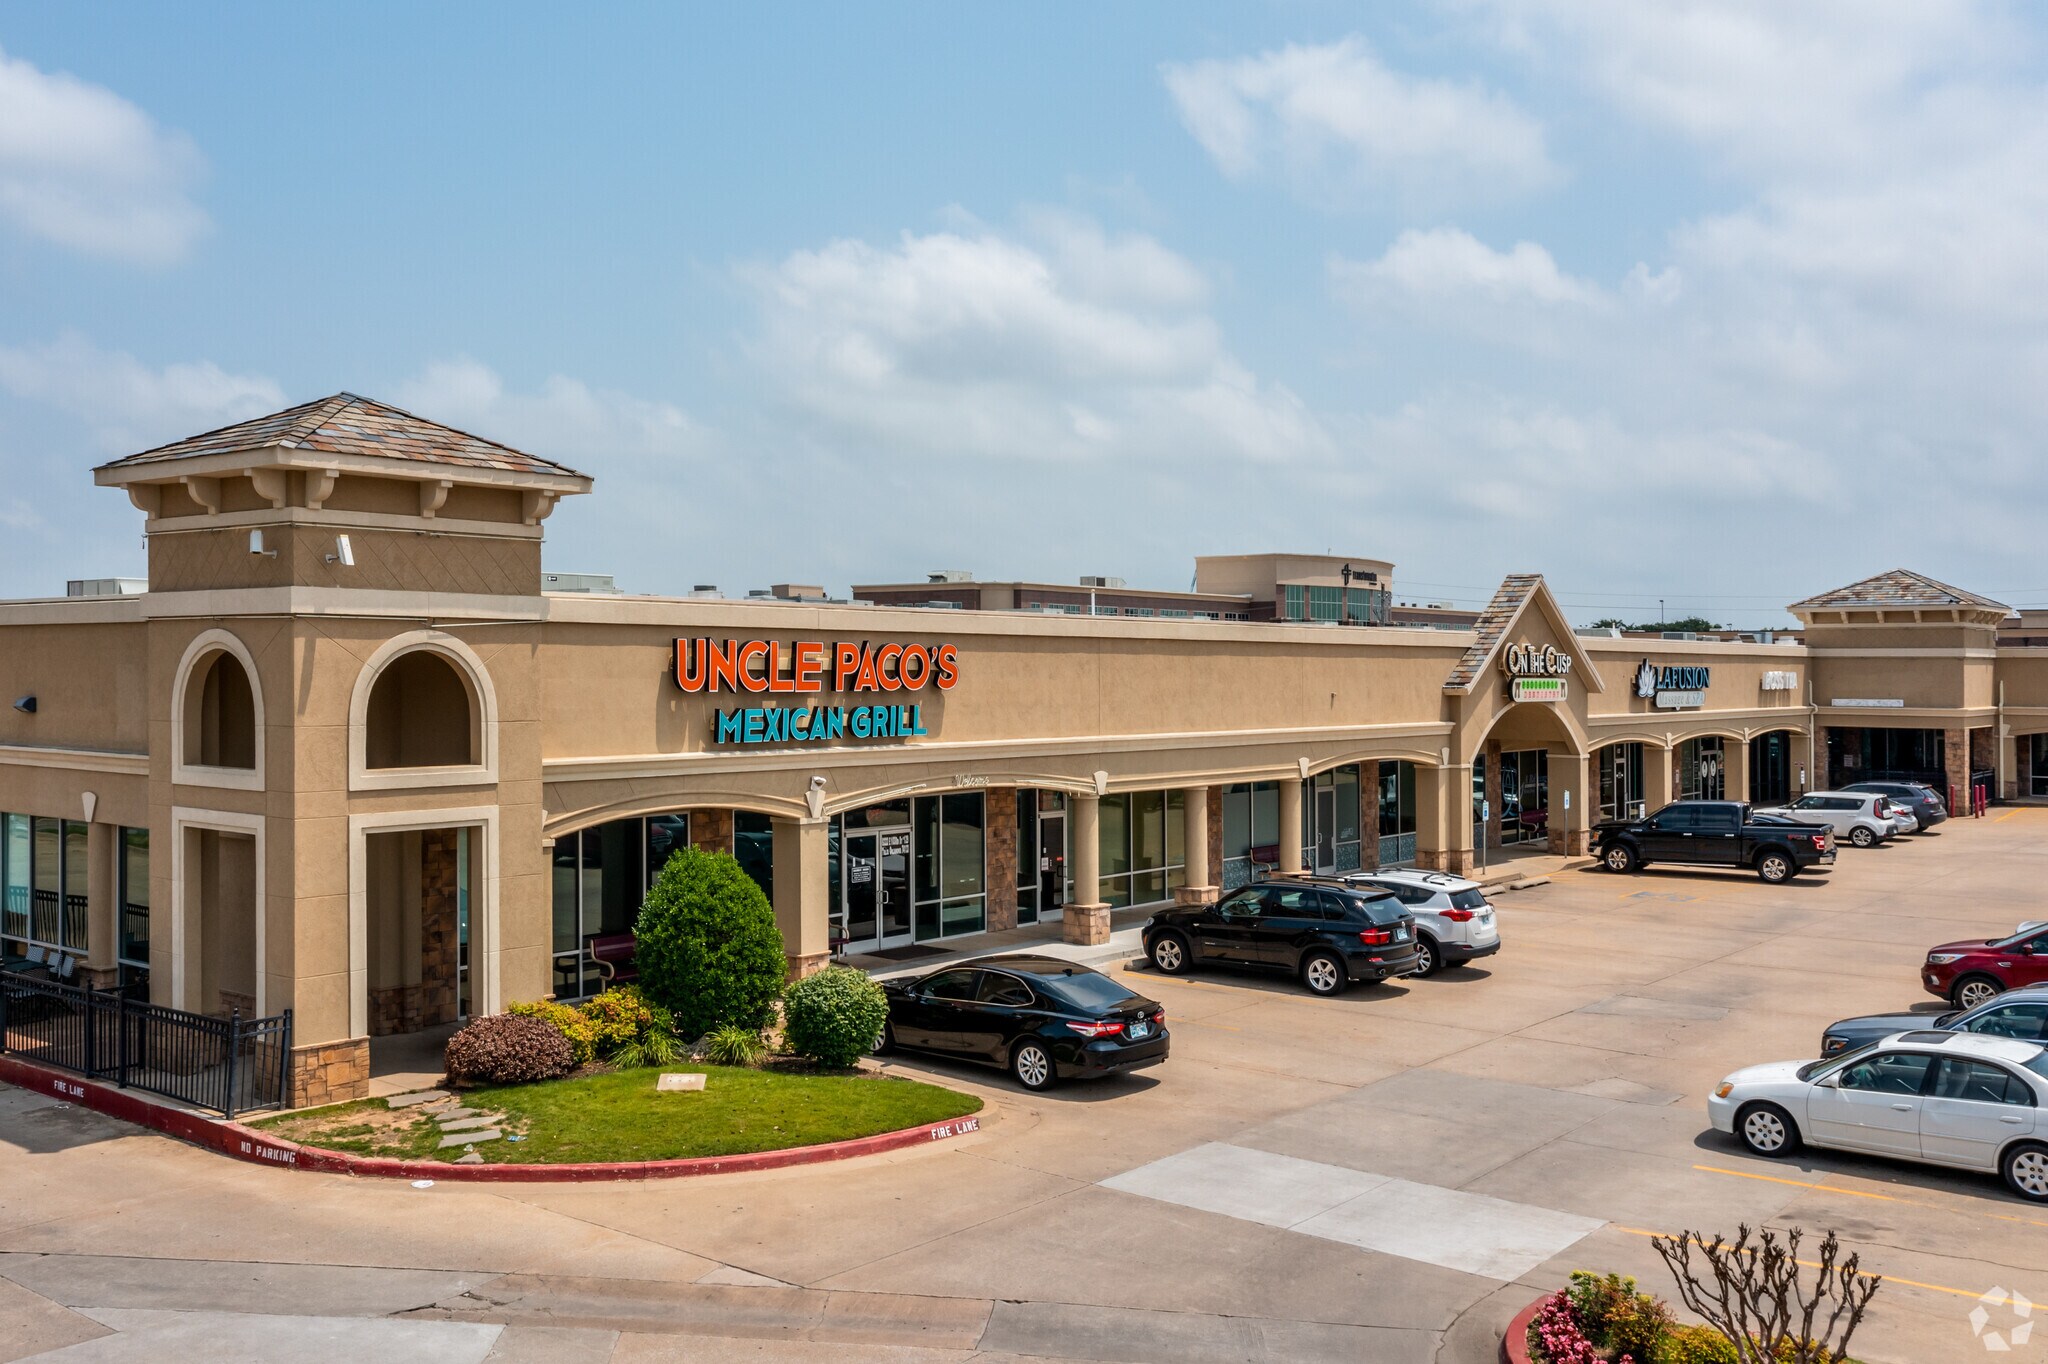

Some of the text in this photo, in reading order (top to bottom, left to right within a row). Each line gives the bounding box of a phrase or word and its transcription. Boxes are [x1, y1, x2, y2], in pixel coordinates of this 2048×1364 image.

[674, 637, 960, 693] UNCLE PACO'S
[1508, 644, 1572, 674] ON THE CUSP
[1655, 666, 1711, 689] LAFUSION
[715, 704, 928, 744] MEXICAN GRILL
[53, 1079, 84, 1098] FIRE LANE
[931, 1119, 978, 1139] FIRE LANE
[240, 1140, 296, 1163] NO PARKING
